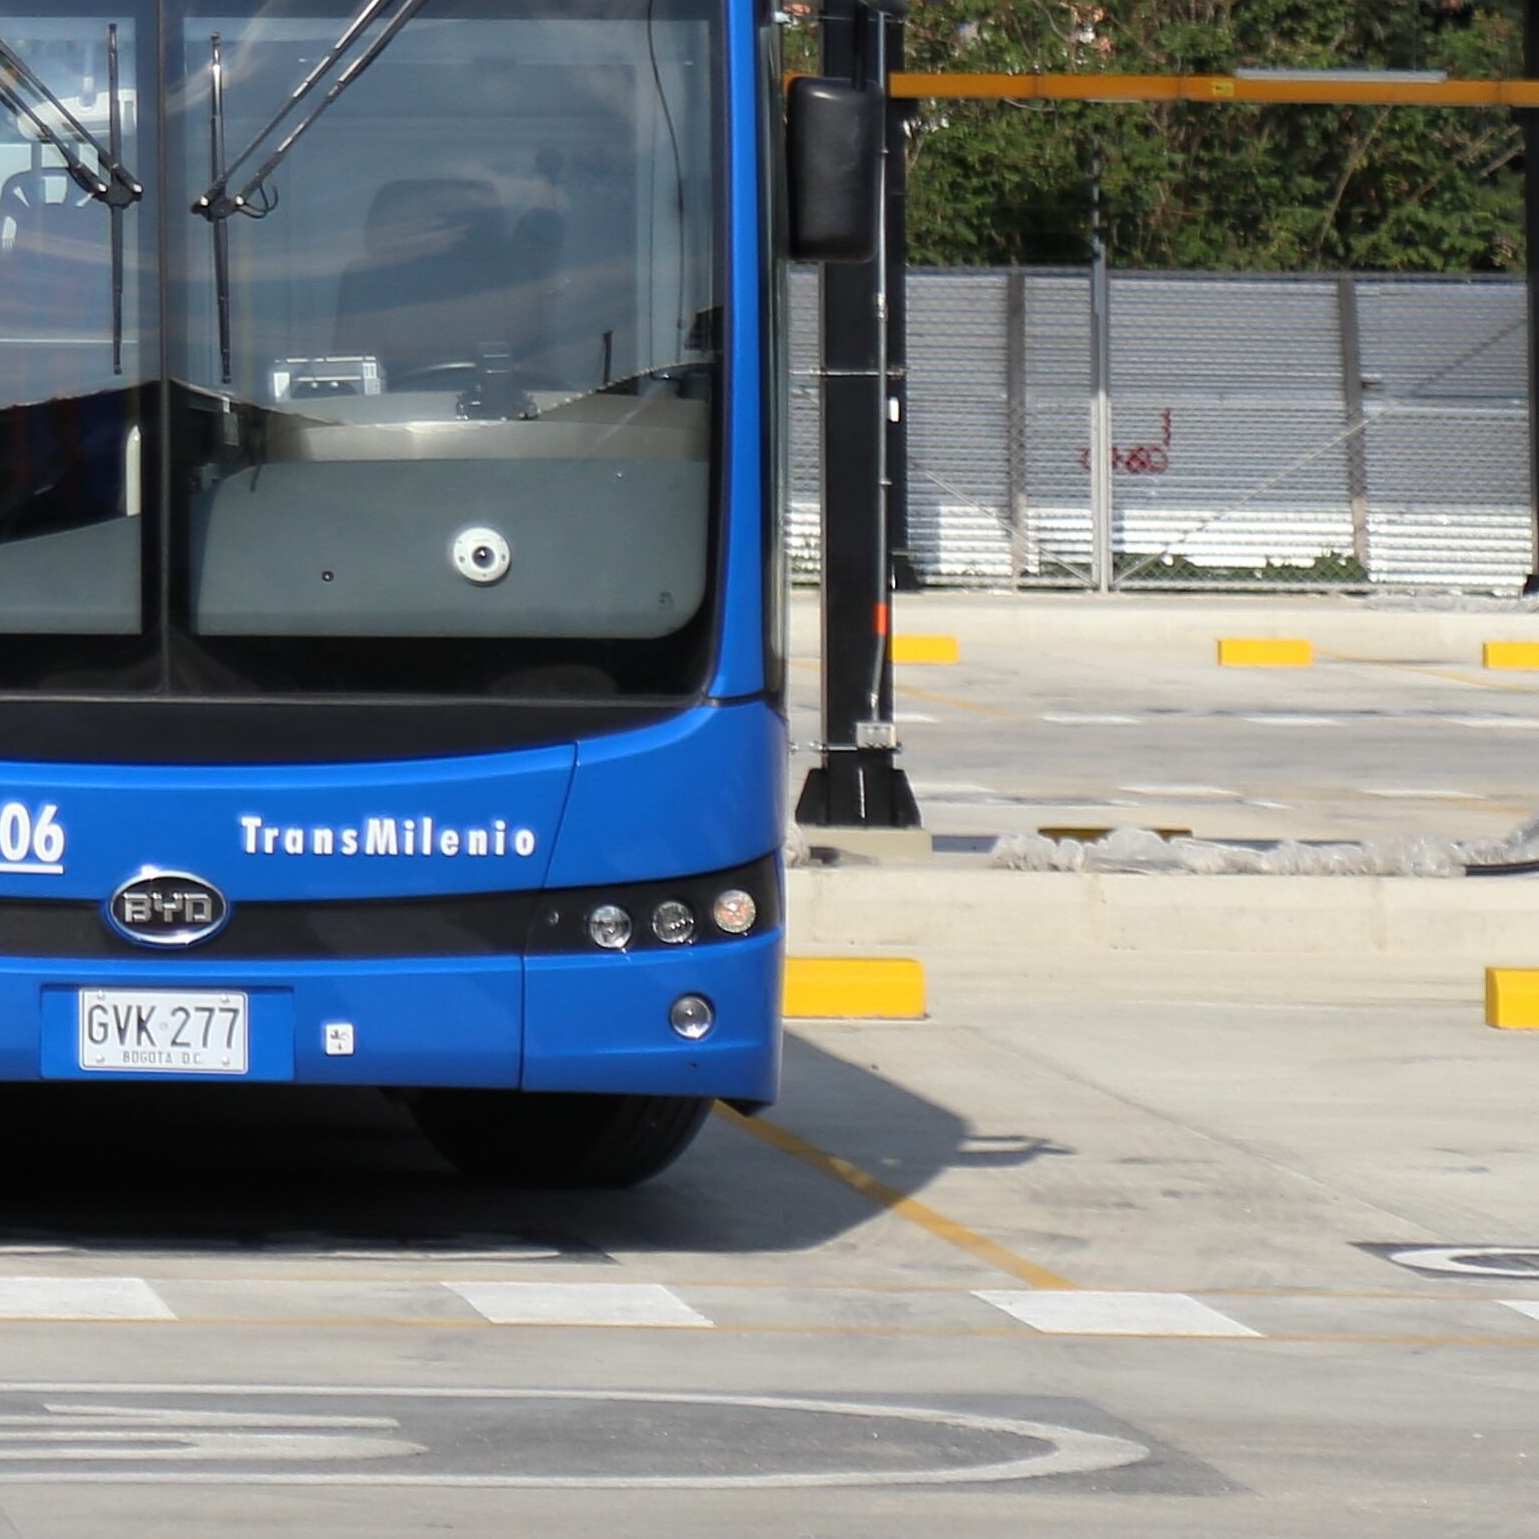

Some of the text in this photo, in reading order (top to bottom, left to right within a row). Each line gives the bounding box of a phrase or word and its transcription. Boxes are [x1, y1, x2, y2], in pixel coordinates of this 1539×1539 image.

[241, 817, 536, 857] TransMilenio
[123, 892, 212, 923] BYD
[88, 1004, 240, 1050] GVK 277
[123, 1051, 173, 1065] BOGOTA
